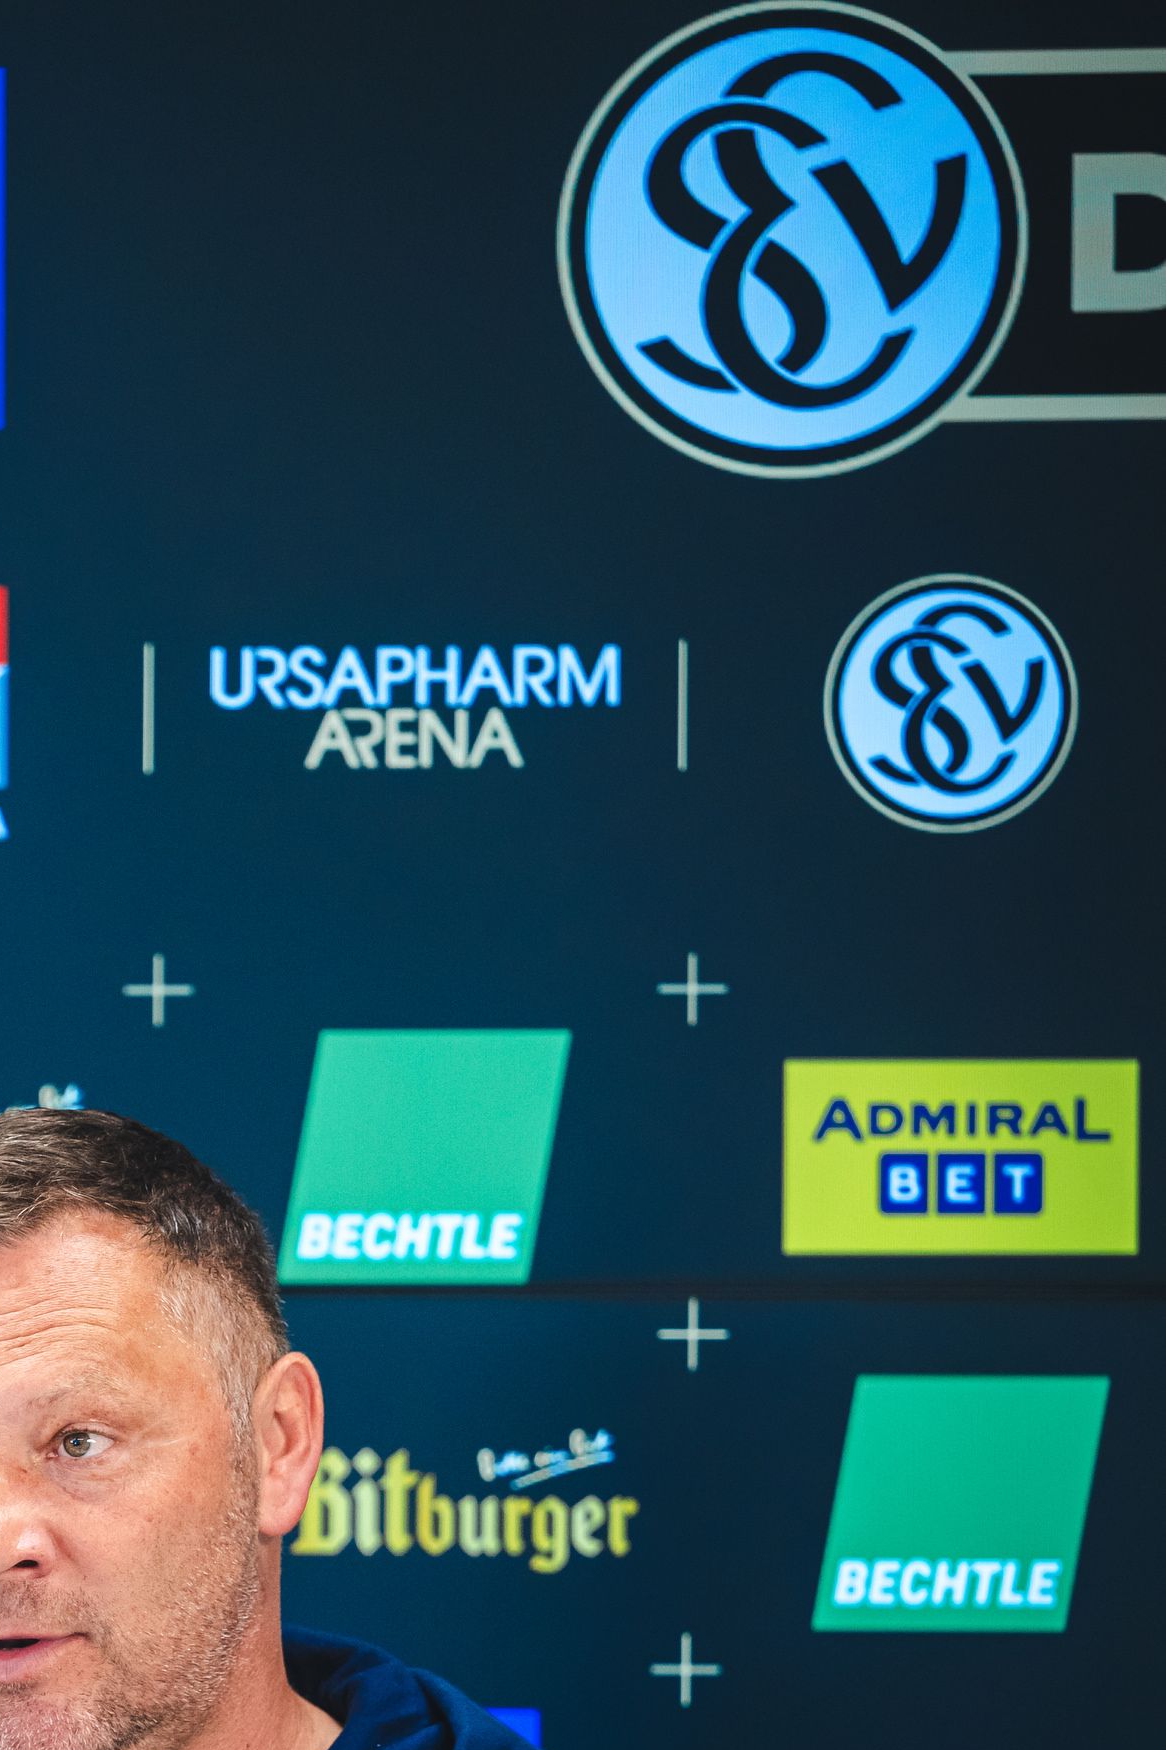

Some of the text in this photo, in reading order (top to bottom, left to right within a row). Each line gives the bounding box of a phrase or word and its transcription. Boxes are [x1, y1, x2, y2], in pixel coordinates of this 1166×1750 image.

[209, 643, 622, 711] URSAPHARM
[303, 706, 526, 771] ARENA
[812, 1096, 1113, 1142] ADMIRAL
[887, 1163, 1035, 1204] BET
[296, 1212, 525, 1262] BECHTLE
[290, 1445, 639, 1575] Bitburger
[834, 1558, 1062, 1608] BECHTLE
